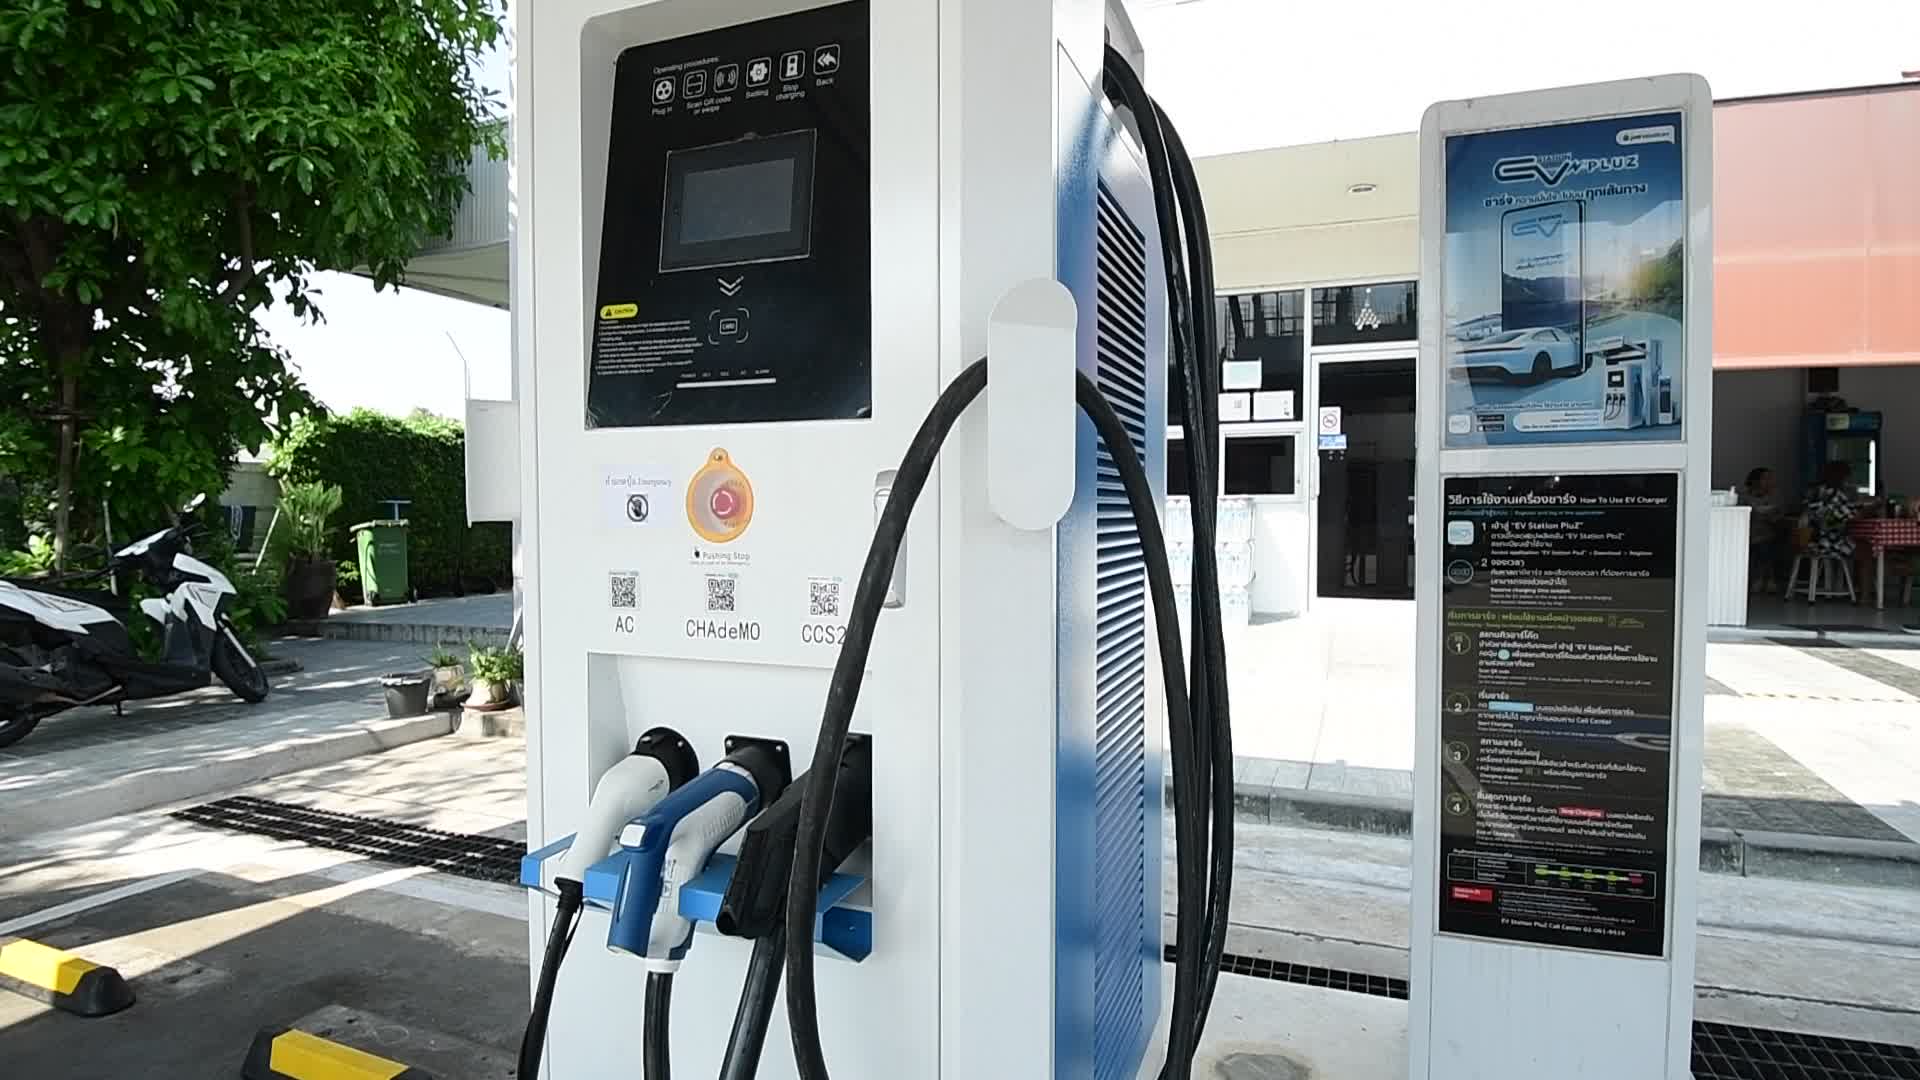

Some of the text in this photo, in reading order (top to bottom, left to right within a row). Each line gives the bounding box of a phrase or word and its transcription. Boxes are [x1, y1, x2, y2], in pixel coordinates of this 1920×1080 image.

[816, 77, 833, 86] Back
[1588, 154, 1639, 171] PLUZ
[1637, 496, 1668, 504] Charger
[1528, 522, 1559, 530] Station
[733, 552, 750, 562] Stop
[1481, 558, 1488, 567] 2
[615, 616, 847, 644] AC CHAdeMO CCS2
[1455, 642, 1461, 653] 1
[1454, 703, 1462, 712] 2
[1454, 751, 1461, 760] 3
[1452, 803, 1461, 812] 4
[1548, 922, 1560, 930] Call
